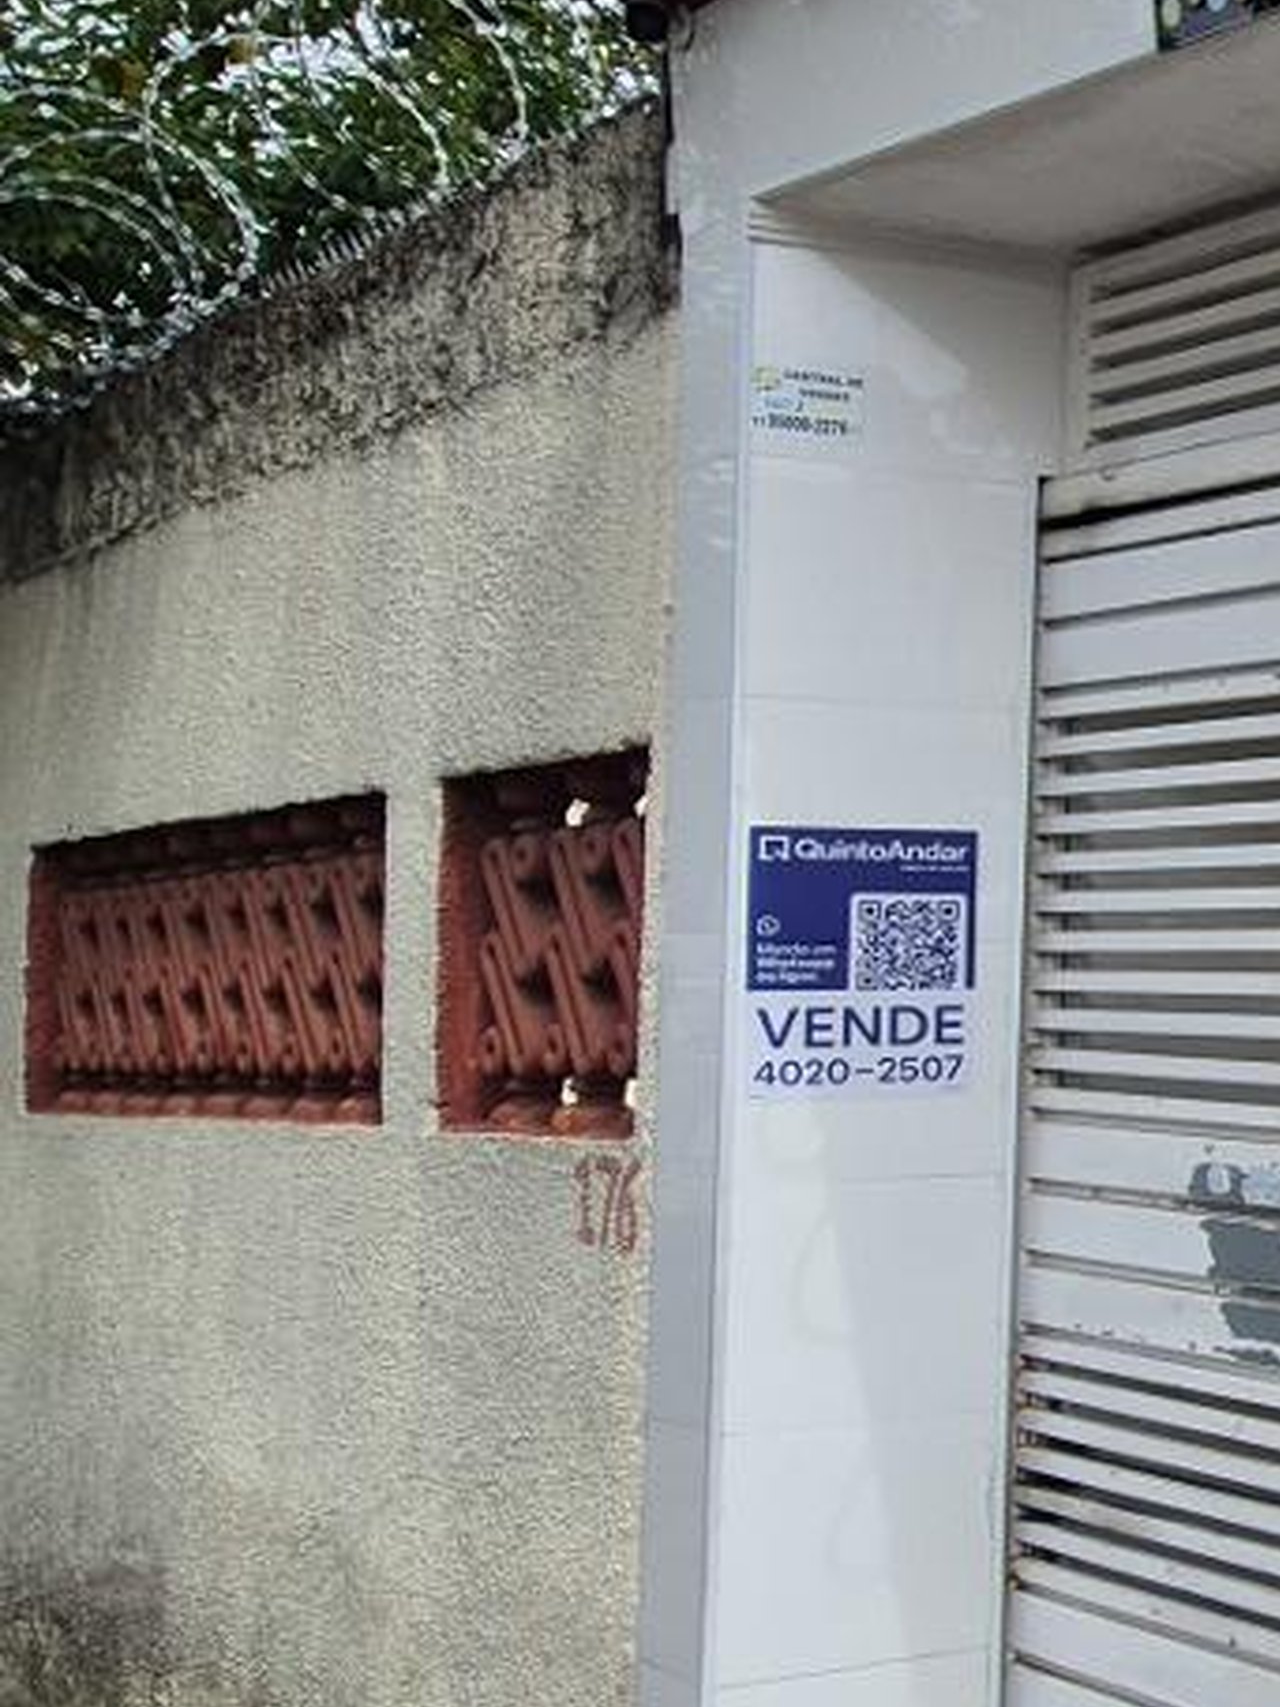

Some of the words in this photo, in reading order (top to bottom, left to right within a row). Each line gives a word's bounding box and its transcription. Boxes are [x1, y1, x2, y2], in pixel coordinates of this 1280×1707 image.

[794, 839, 969, 861] QuintoAndar
[757, 1004, 964, 1049] VENDE
[753, 1054, 964, 1086] 4020-2507
